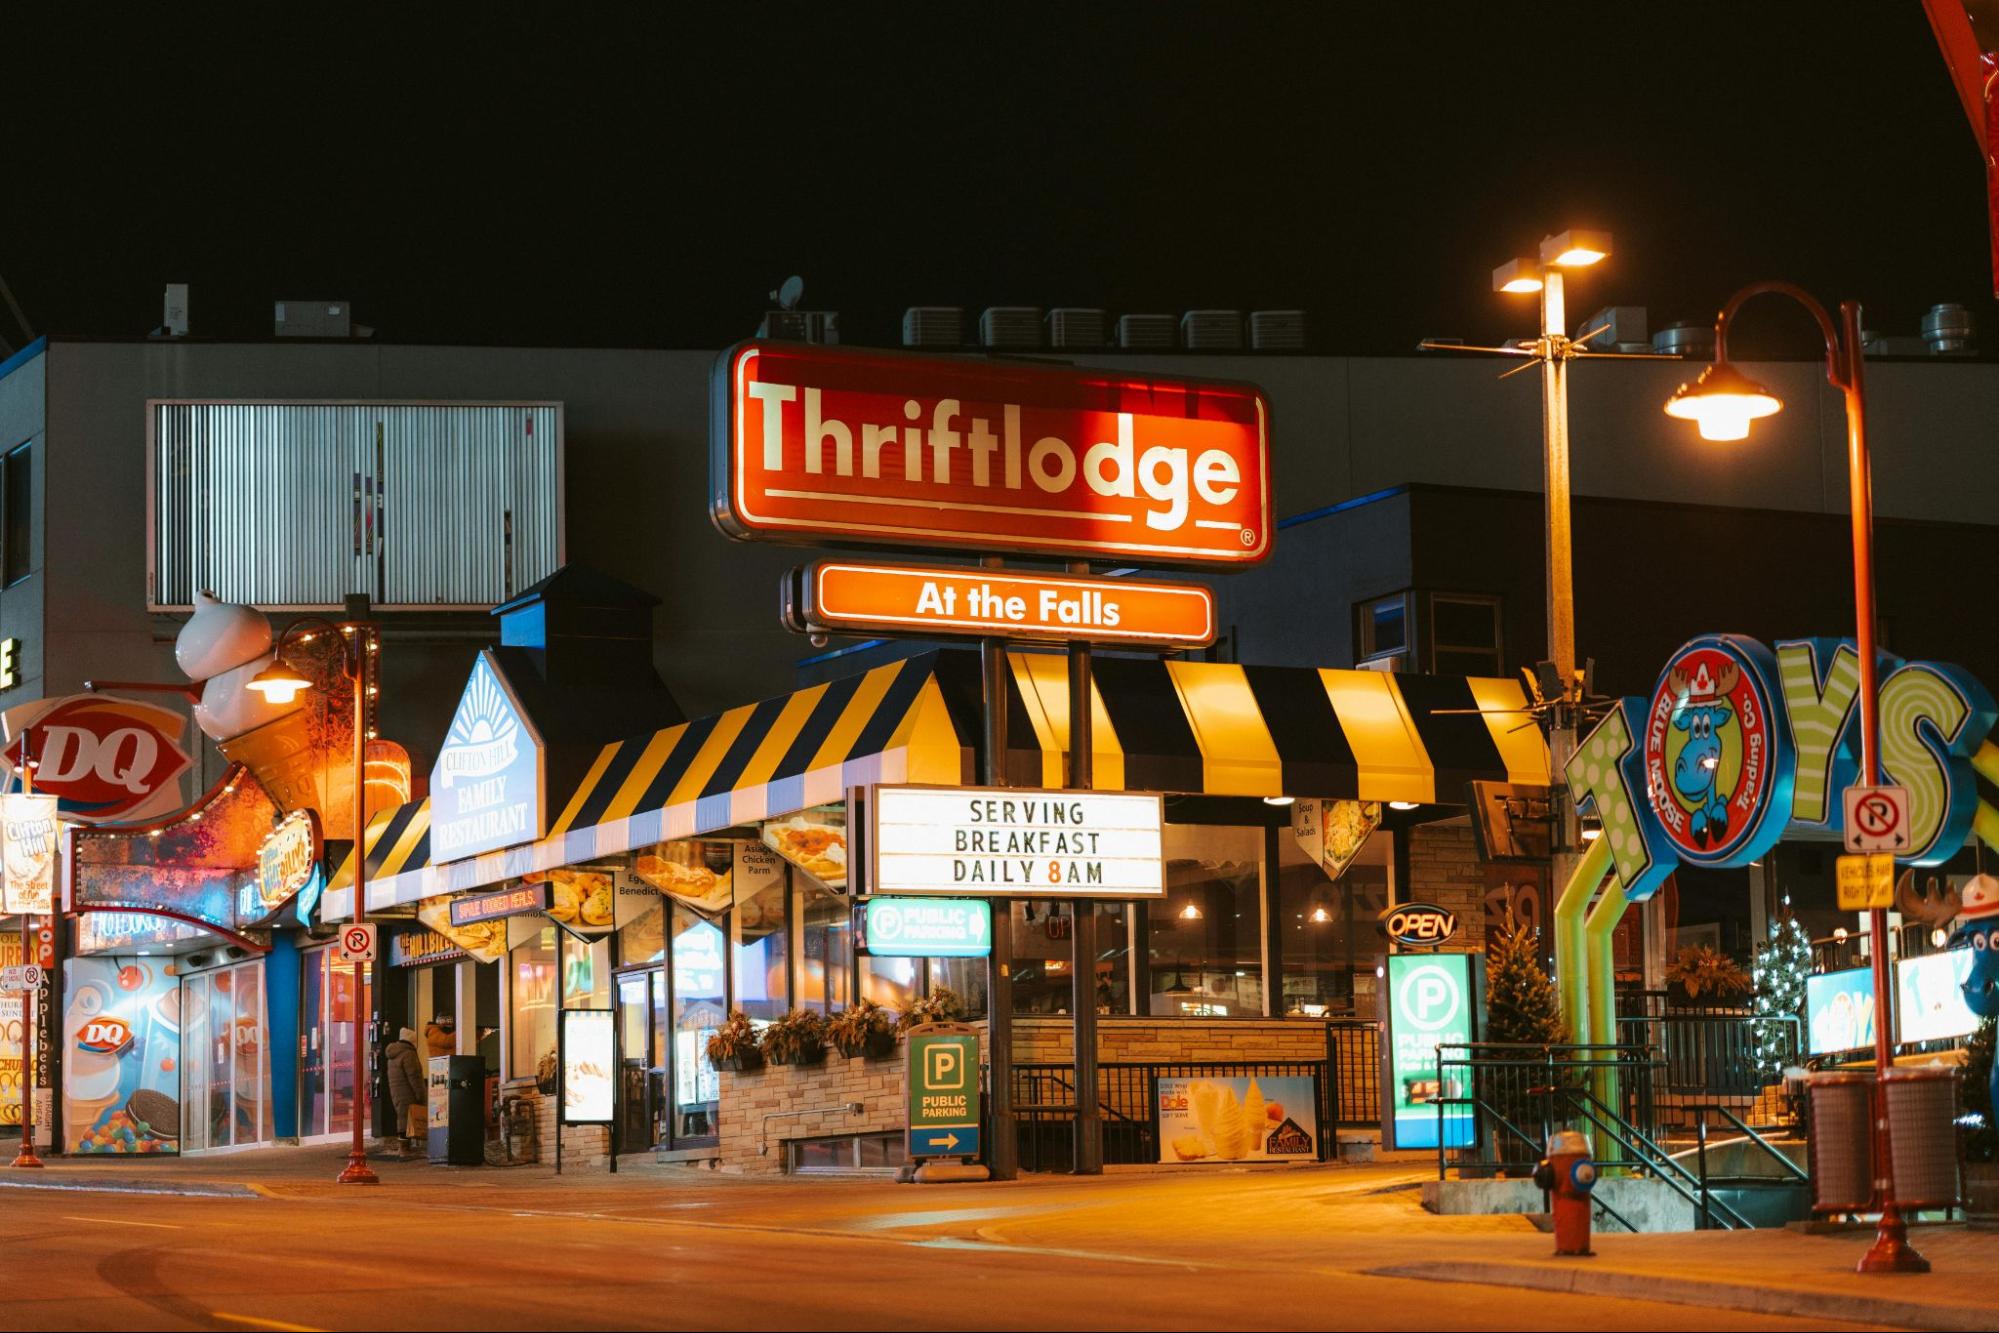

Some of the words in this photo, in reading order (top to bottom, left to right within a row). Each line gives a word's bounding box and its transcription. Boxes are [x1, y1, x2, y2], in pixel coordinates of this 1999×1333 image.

[749, 382, 1241, 531] Thriftlodge
[915, 582, 957, 616] At
[967, 584, 1027, 620] the
[1039, 589, 1120, 626] Falls
[1650, 692, 1672, 752] BLUE
[34, 725, 158, 794] DQ
[446, 749, 487, 771] CLIFTON
[488, 740, 513, 767] HILL
[1737, 733, 1761, 811] Trading
[458, 775, 508, 814] FAMILY
[1650, 758, 1684, 834] MOOSE
[970, 800, 1084, 825] SERVING
[1298, 804, 1313, 813] Soup
[7, 818, 54, 841] Clifton
[439, 802, 528, 849] RESTAURANT
[1296, 827, 1316, 837] Salads
[21, 836, 49, 858] Hill
[955, 830, 1100, 854] BREAKFAST
[742, 855, 776, 865] Chicken
[748, 866, 771, 875] Parm
[953, 860, 1034, 883] DAILY
[1048, 861, 1102, 884] 8AM
[619, 886, 659, 896] Benedict
[903, 907, 967, 924] PUBLIC
[1388, 913, 1454, 937] OPEN
[903, 925, 968, 939] PARKING
[86, 1024, 124, 1046] DQ
[922, 1096, 967, 1107] PUBLIC
[922, 1107, 967, 1118] PARKING
[1160, 1095, 1189, 1109] Dole
[1269, 1136, 1310, 1148] FAMILY
